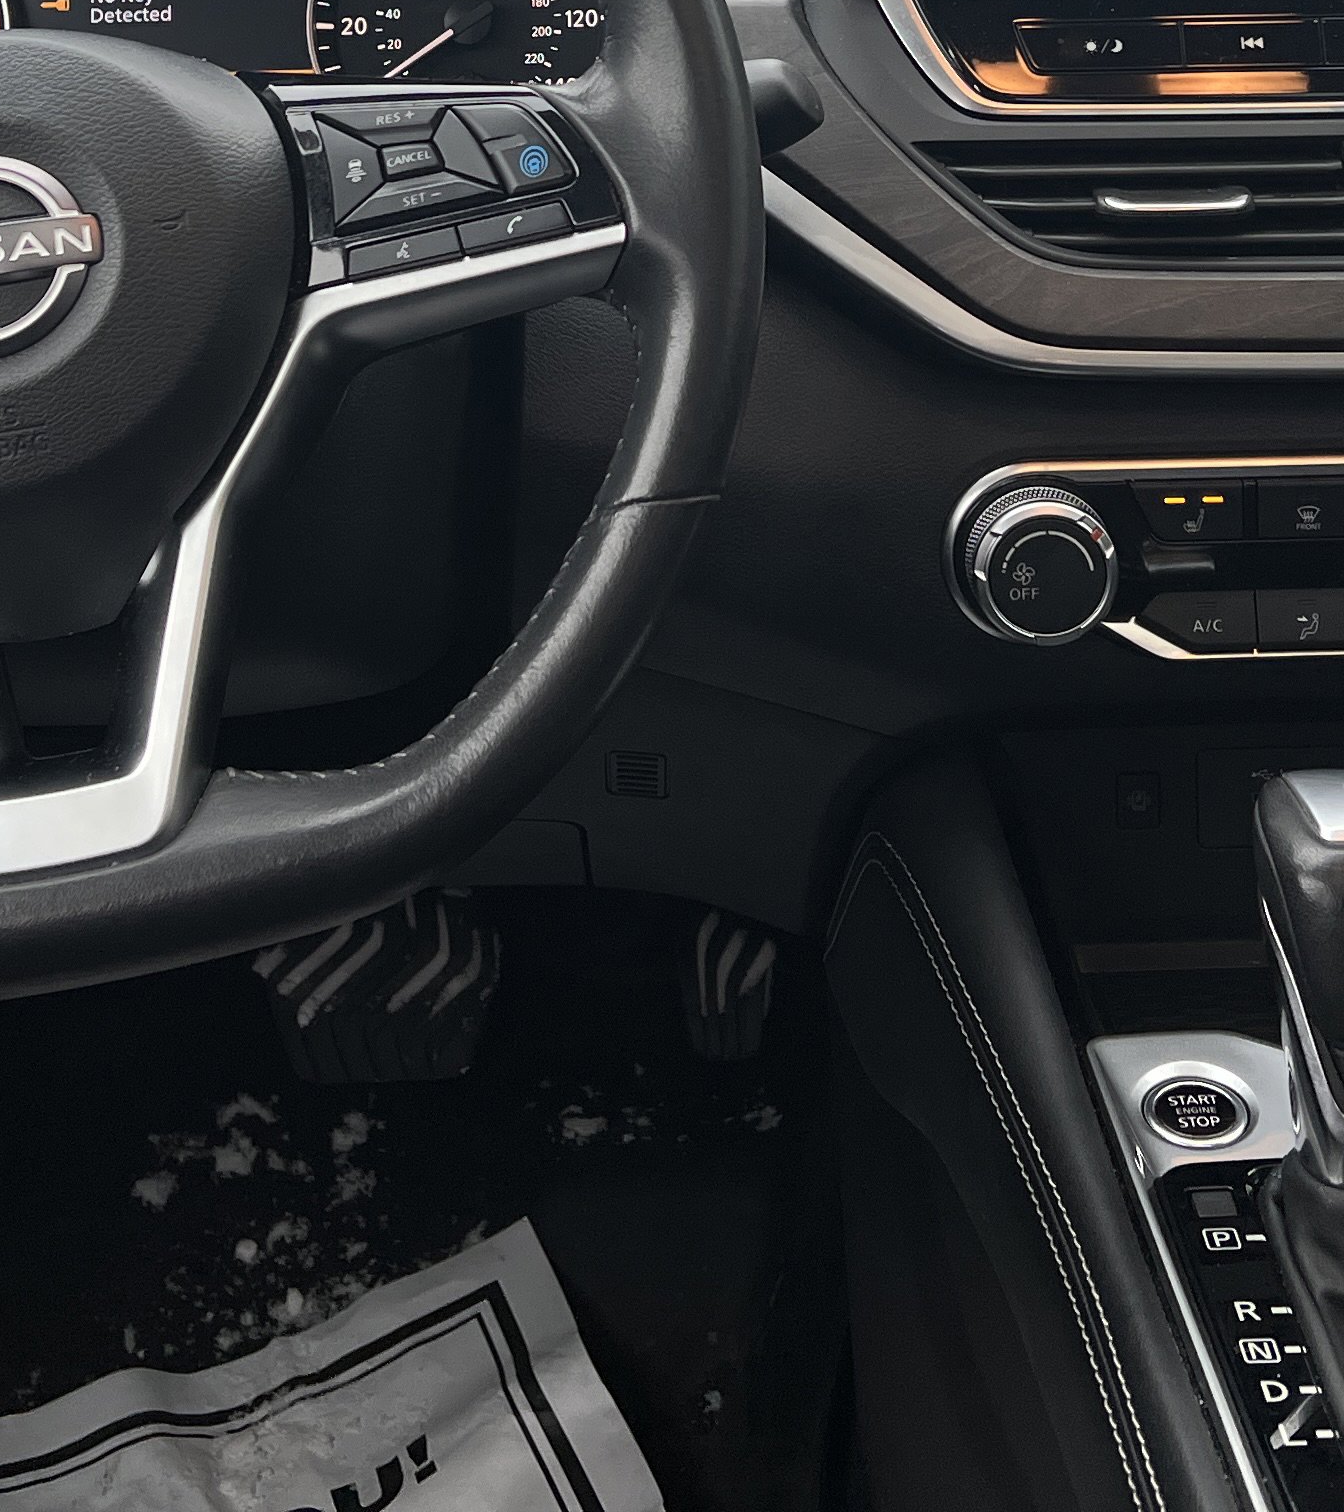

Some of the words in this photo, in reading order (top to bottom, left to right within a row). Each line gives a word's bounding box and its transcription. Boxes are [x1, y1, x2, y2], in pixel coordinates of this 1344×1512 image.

[90, 5, 172, 24] Detected
[385, 8, 401, 20] 40
[564, 9, 598, 28] 120
[341, 17, 368, 36] 20
[531, 26, 553, 38] 200
[387, 38, 402, 50] 20
[524, 53, 545, 65] 220
[376, 111, 401, 126] RES
[386, 150, 432, 169] CANCEL
[402, 191, 425, 208] SET
[1009, 588, 1040, 601] OFF
[1192, 619, 1224, 633] A/C
[1167, 1094, 1217, 1107] START
[1176, 1106, 1217, 1115] ENGINE
[1178, 1116, 1220, 1128] STOP
[1211, 1230, 1231, 1247] P
[1234, 1301, 1261, 1321] R
[1249, 1342, 1271, 1359] N
[1260, 1380, 1289, 1403] D
[1278, 1423, 1308, 1446] L
